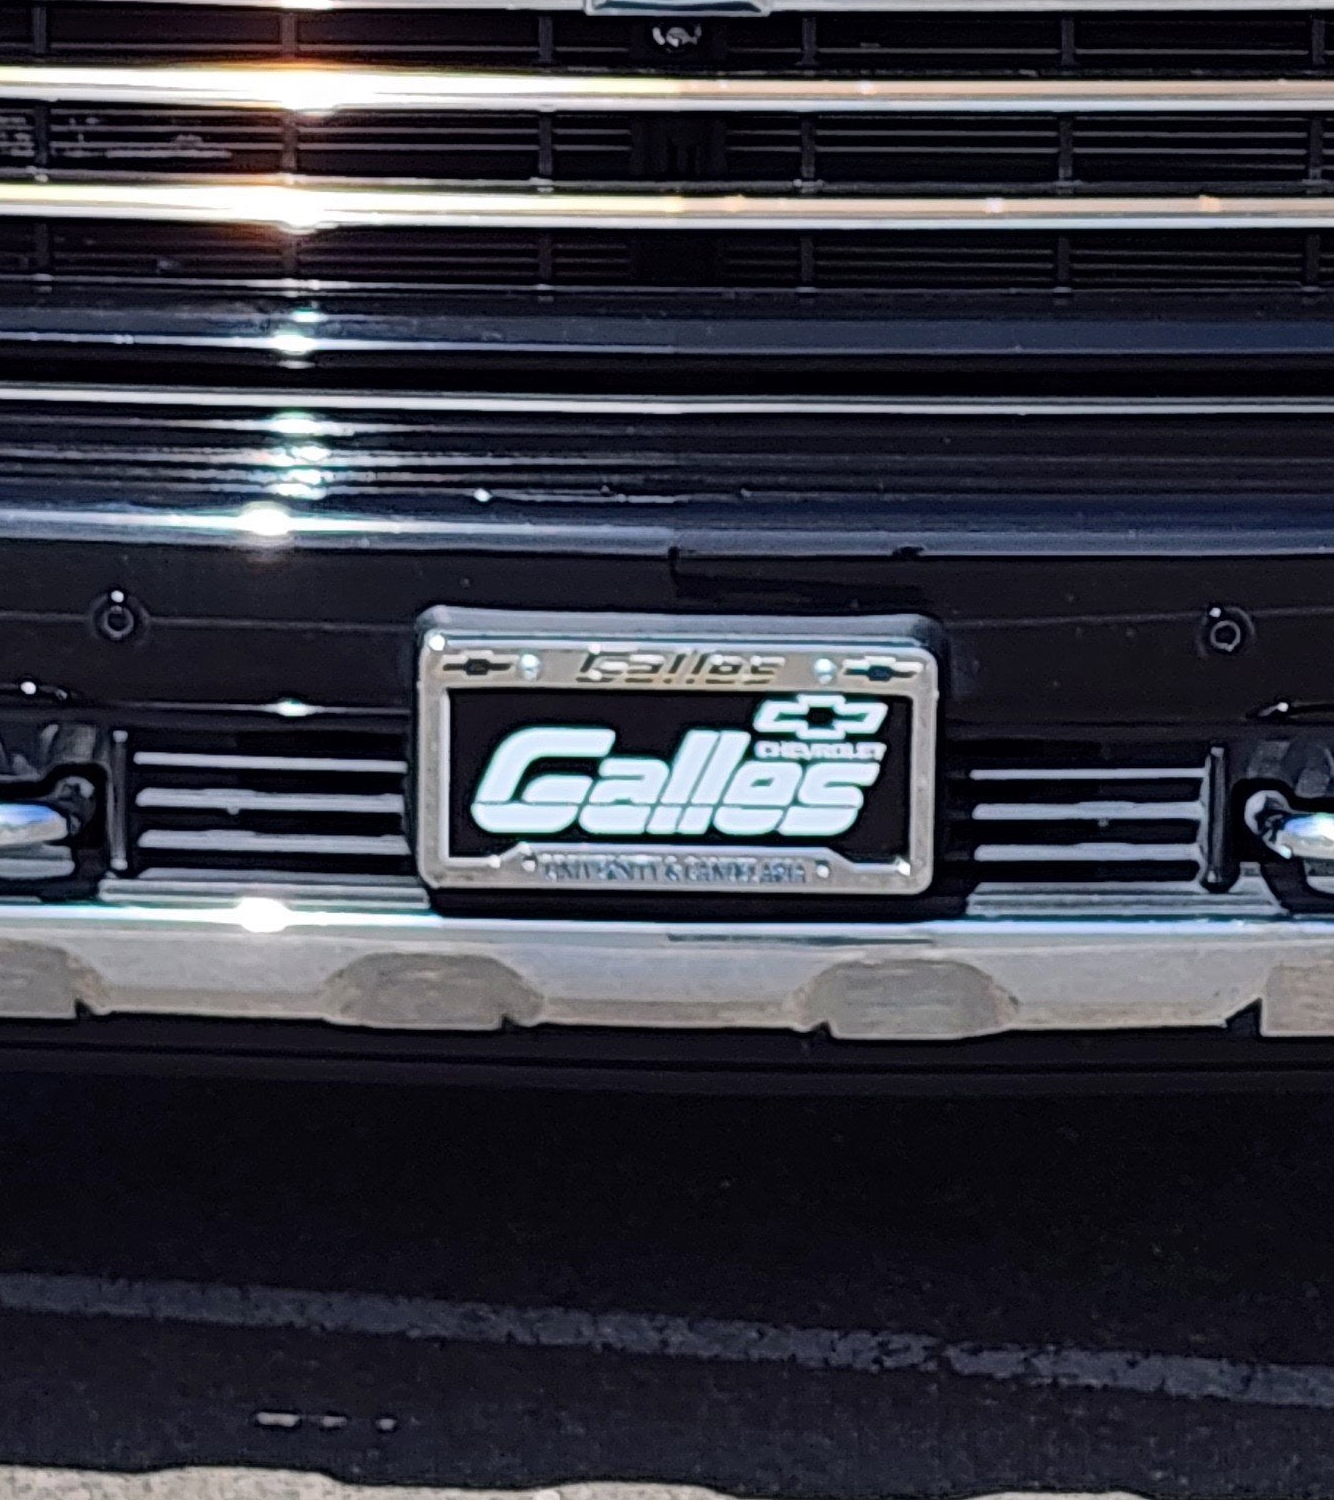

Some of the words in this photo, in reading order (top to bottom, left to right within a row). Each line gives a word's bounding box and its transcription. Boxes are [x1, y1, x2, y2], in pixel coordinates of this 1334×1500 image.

[575, 643, 786, 685] Galles
[754, 740, 887, 761] CHEVROLET
[470, 726, 881, 838] Galles
